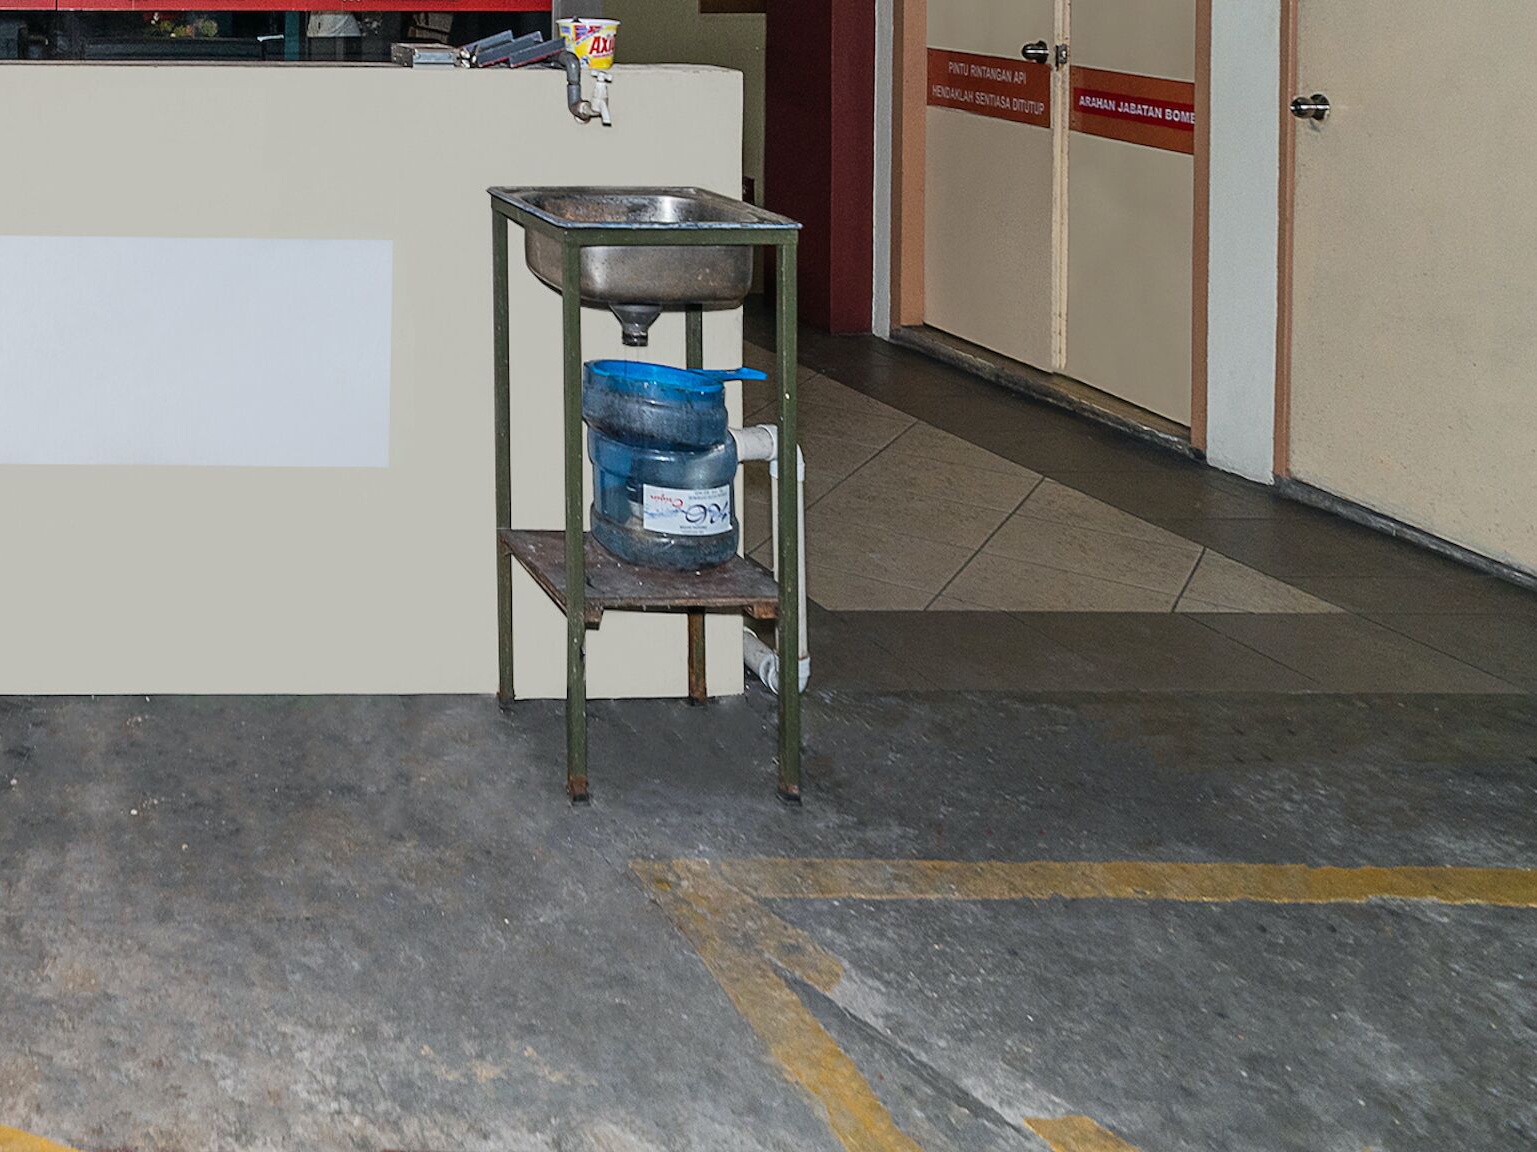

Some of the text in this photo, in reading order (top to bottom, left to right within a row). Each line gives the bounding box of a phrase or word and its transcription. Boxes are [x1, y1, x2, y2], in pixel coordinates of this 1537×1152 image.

[948, 61, 1027, 85] PINTU RINTANGAN API
[932, 84, 1045, 116] HENDAKLAH SENTIASA DITUTUP
[1078, 95, 1116, 111] ARAHAN
[1117, 101, 1162, 119] JABATAN
